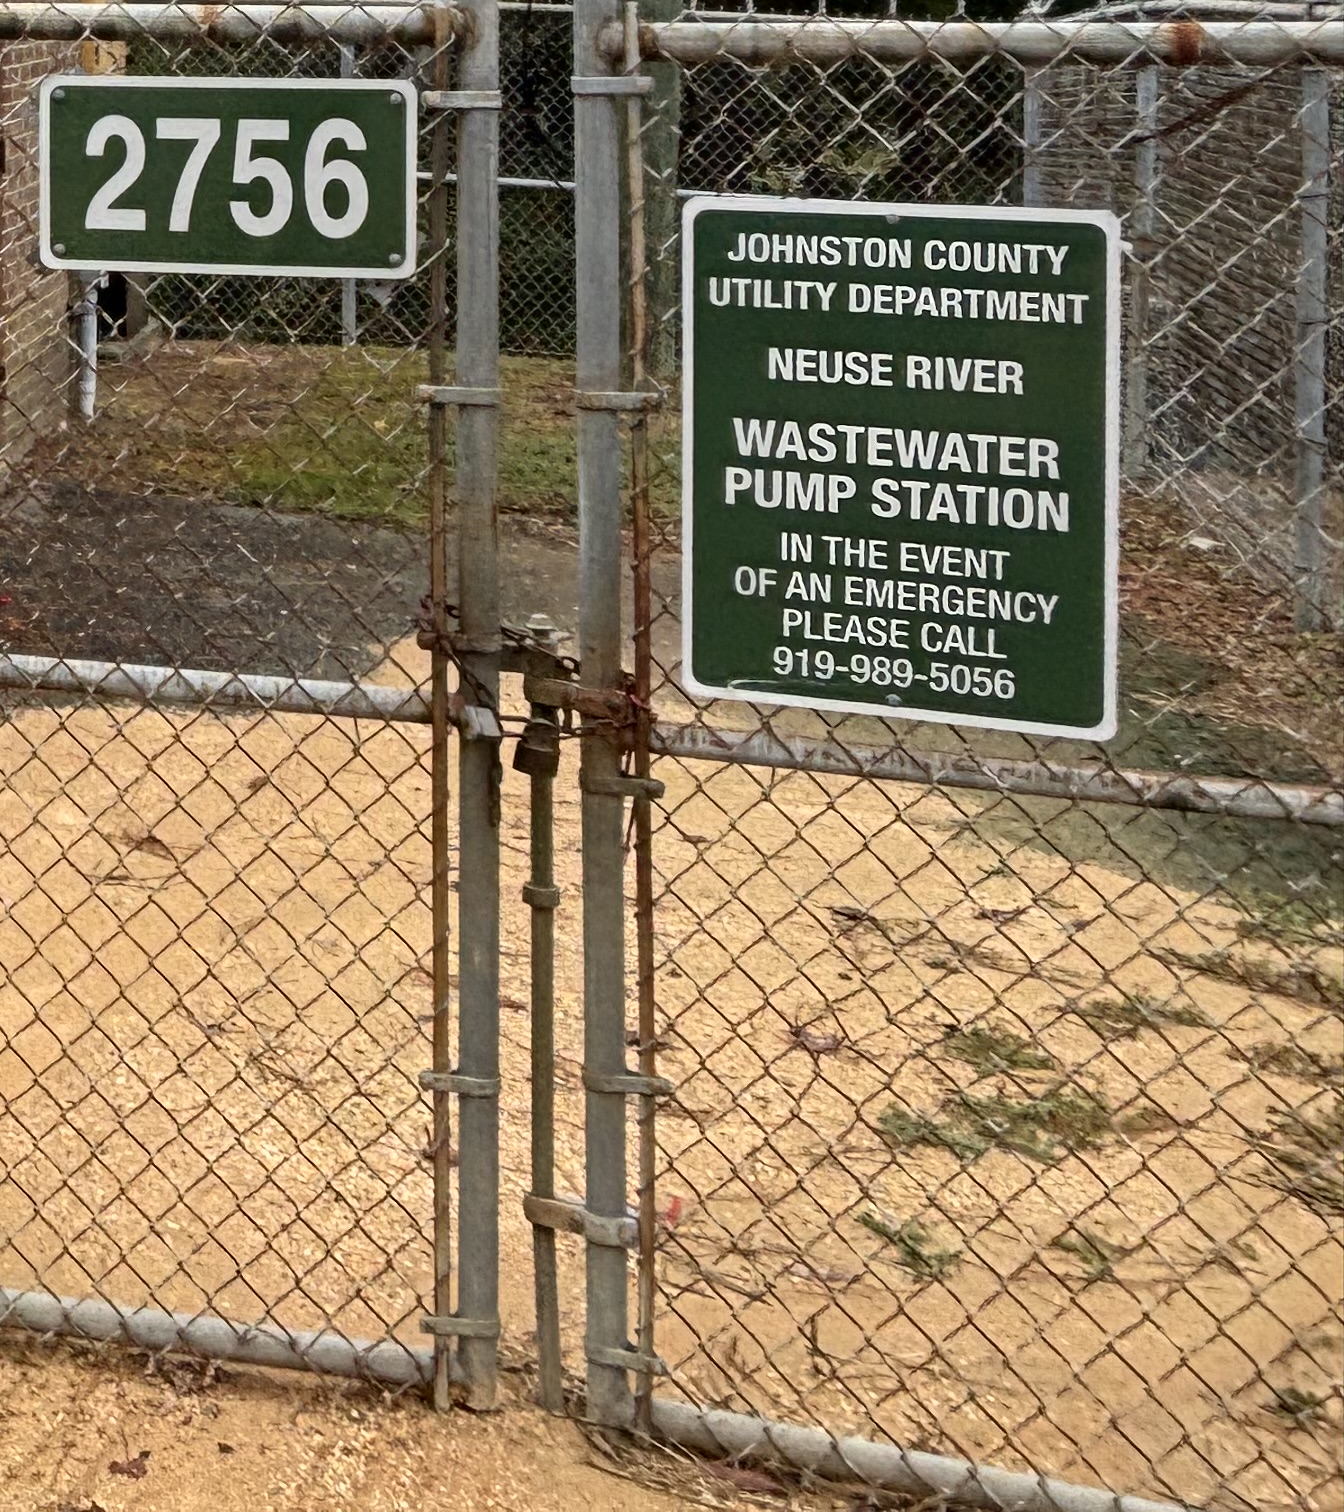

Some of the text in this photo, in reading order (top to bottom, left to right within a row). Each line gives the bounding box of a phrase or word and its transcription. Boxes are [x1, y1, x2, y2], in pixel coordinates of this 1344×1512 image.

[85, 114, 369, 239] 2756
[727, 232, 1070, 276] JOHNSTON COUNTY
[708, 276, 1090, 325] UTILITY DEPARTMENT
[768, 347, 1024, 395] NEUSE RIVER
[732, 417, 1060, 480] WASTEWATER
[724, 466, 1070, 533] PUMP STATION
[780, 531, 1011, 581] IN THE EVENT
[734, 565, 1060, 625] OF AN EMERGENCY
[782, 608, 1008, 659] PLEASE CALL
[772, 645, 1016, 700] 919-989-5056
